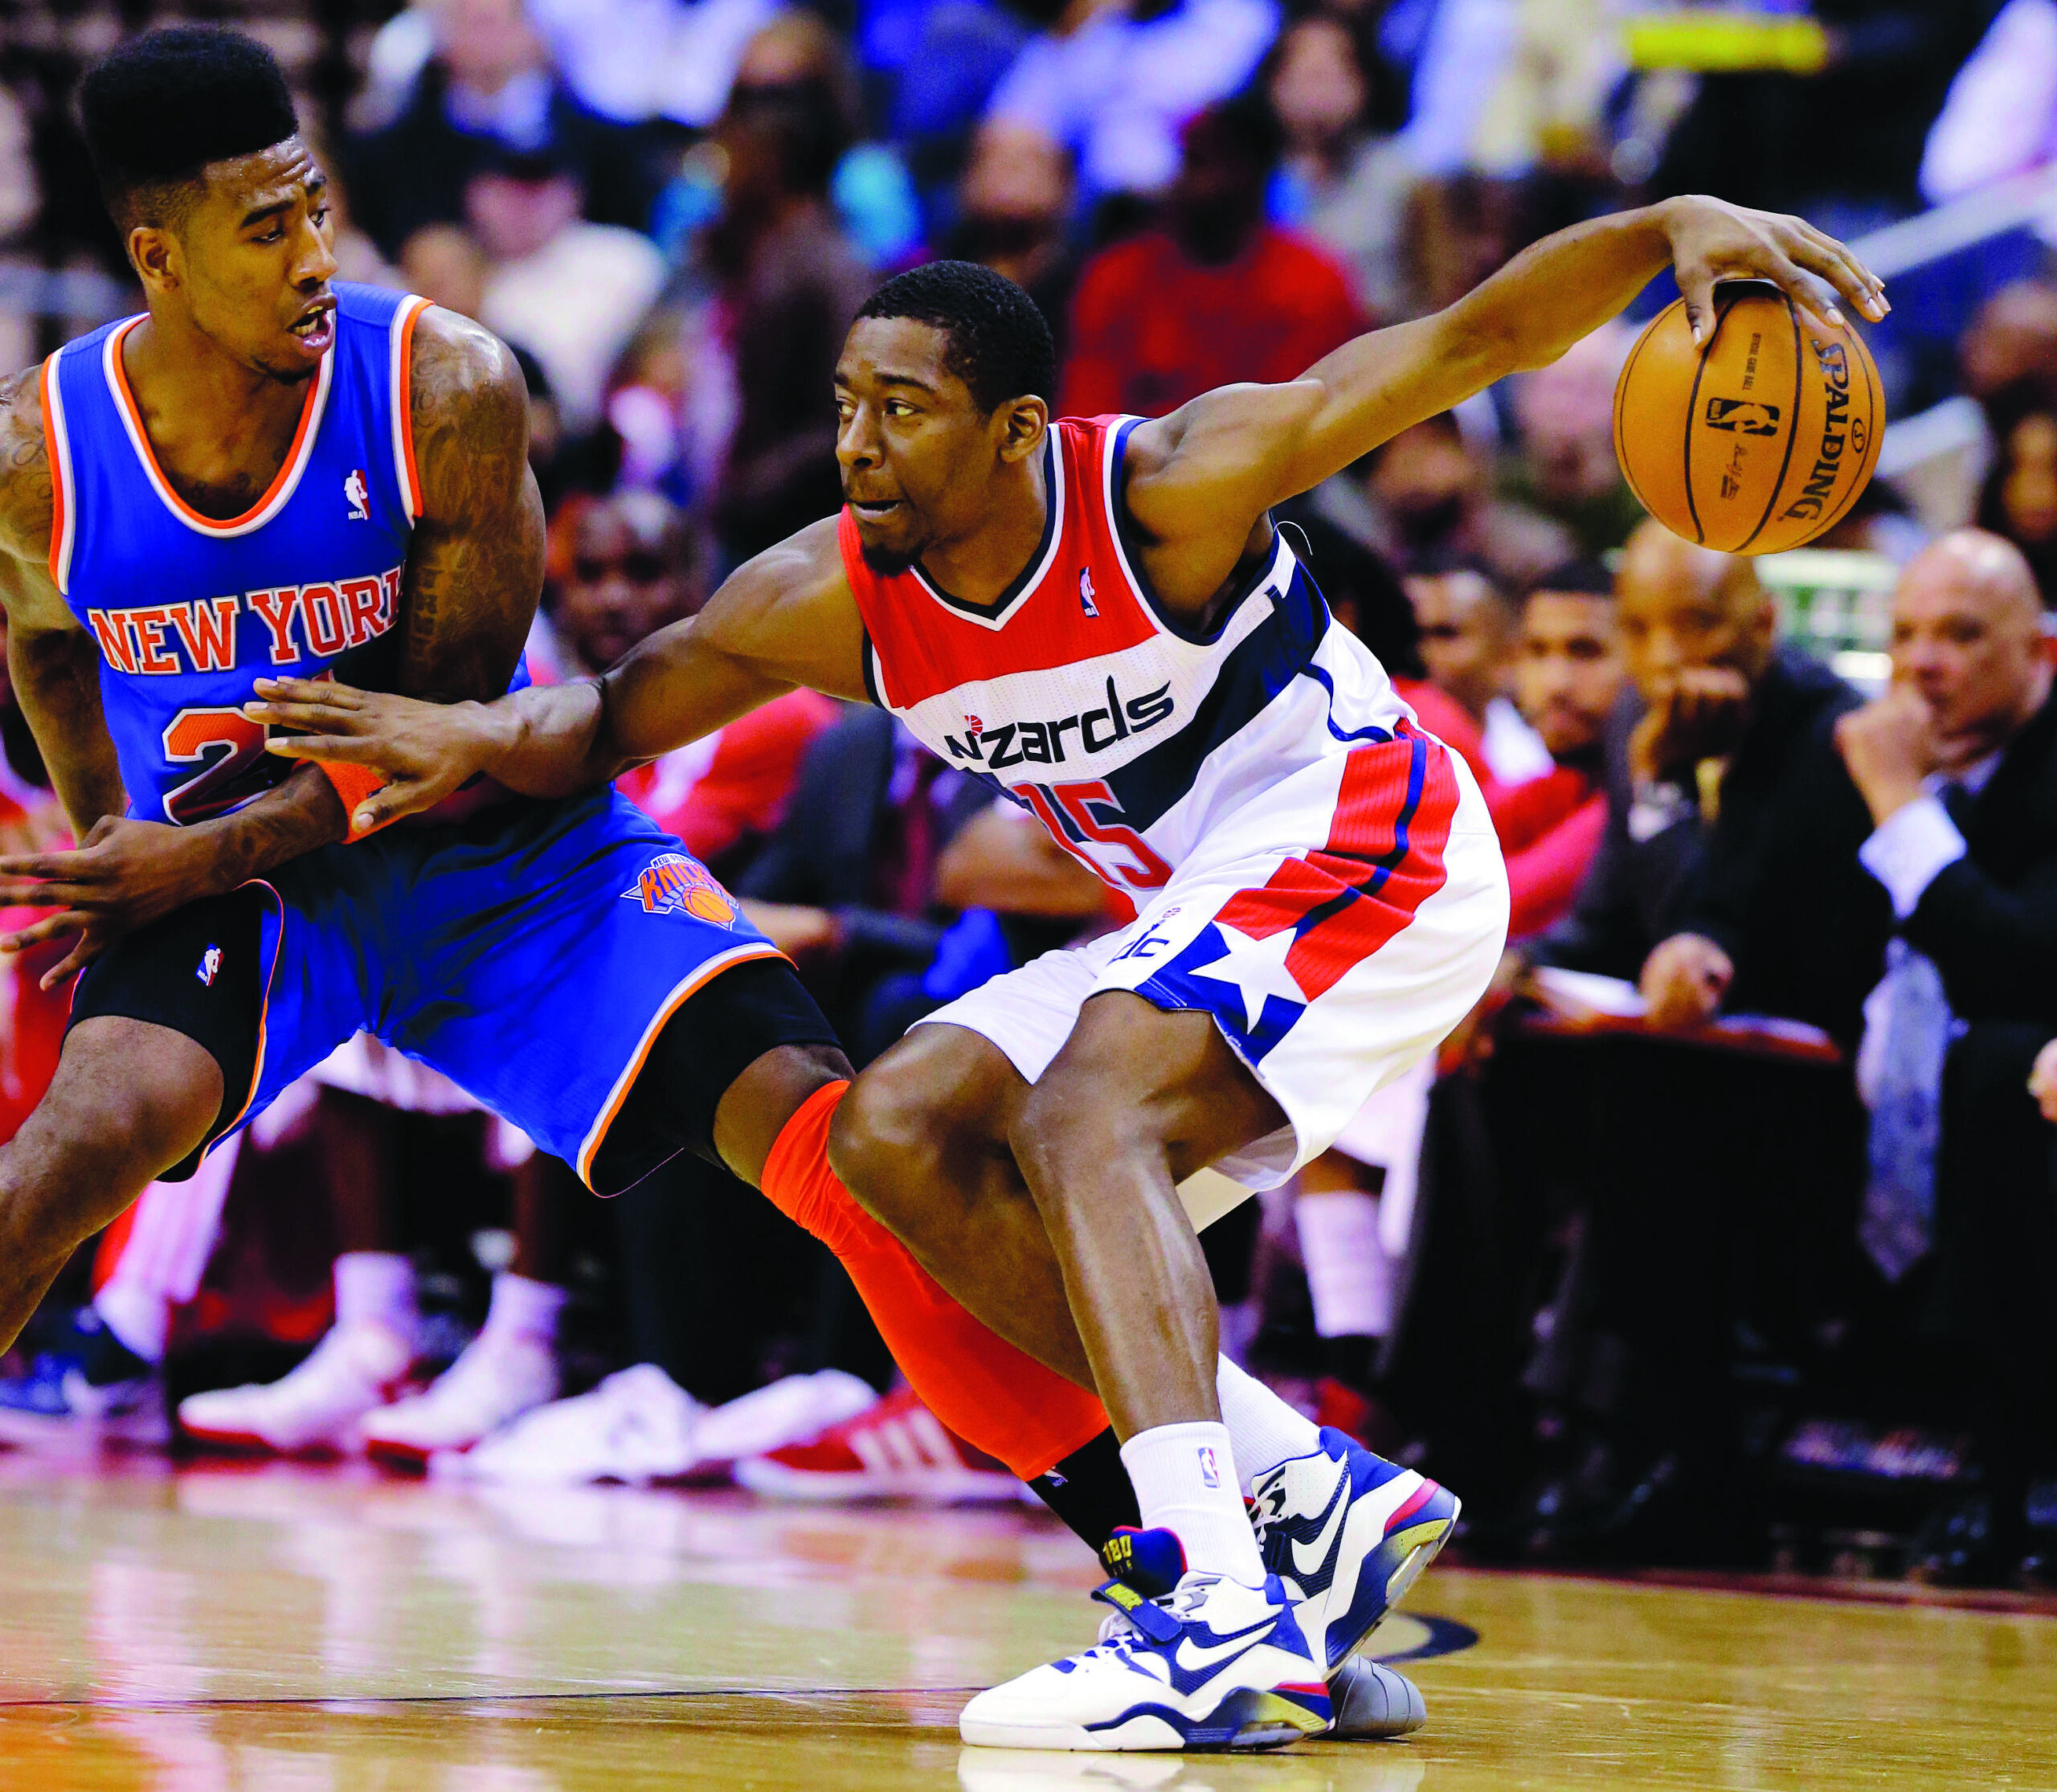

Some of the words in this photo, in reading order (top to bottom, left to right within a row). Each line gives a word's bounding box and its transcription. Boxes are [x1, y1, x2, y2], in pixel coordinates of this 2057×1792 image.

[1784, 339, 1850, 521] SPALDING
[348, 510, 364, 521] NBA
[88, 595, 240, 675] NEW
[162, 707, 270, 826] 2
[1007, 779, 1175, 891] 15
[640, 862, 736, 910] KNIC
[1102, 1535, 1132, 1565] 180
